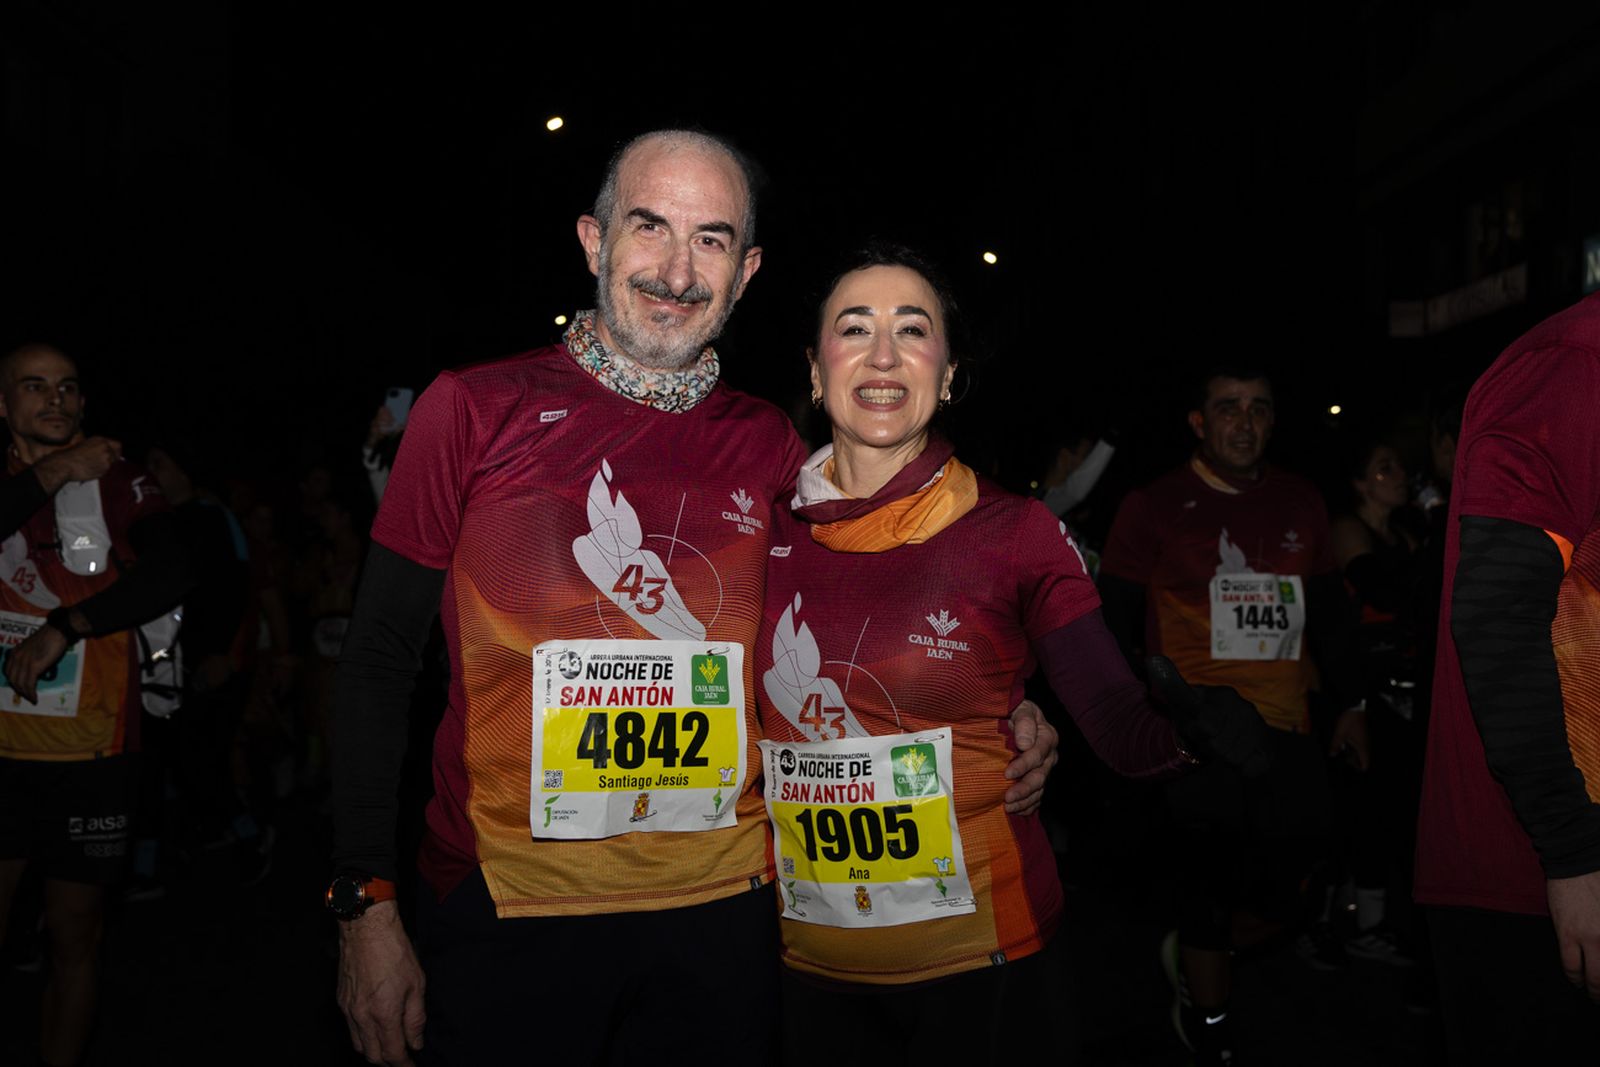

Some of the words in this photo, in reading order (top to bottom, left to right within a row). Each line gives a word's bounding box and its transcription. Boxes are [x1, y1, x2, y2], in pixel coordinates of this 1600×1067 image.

[722, 511, 742, 523] CAJA
[12, 567, 36, 594] 43
[612, 564, 668, 615] 43
[1232, 605, 1289, 629] 1443
[909, 633, 934, 647] CAJA
[937, 638, 970, 652] RURAL
[586, 662, 649, 680] NOCHE
[650, 662, 674, 680] DE
[560, 686, 603, 706] SAN
[606, 682, 674, 706] ANTÓN
[799, 693, 846, 739] 43
[576, 711, 710, 769] 4842
[780, 751, 796, 770] 43
[831, 752, 871, 760] INTERNACIONAL
[799, 761, 845, 779] NOCHE
[850, 760, 873, 777] DE
[598, 775, 652, 790] Santiago
[655, 773, 689, 787] Jesús
[781, 781, 811, 803] SAN
[814, 778, 875, 804] ANTÓN
[87, 815, 127, 832] alsa
[796, 804, 920, 862] 1905
[848, 867, 870, 880] Ana
